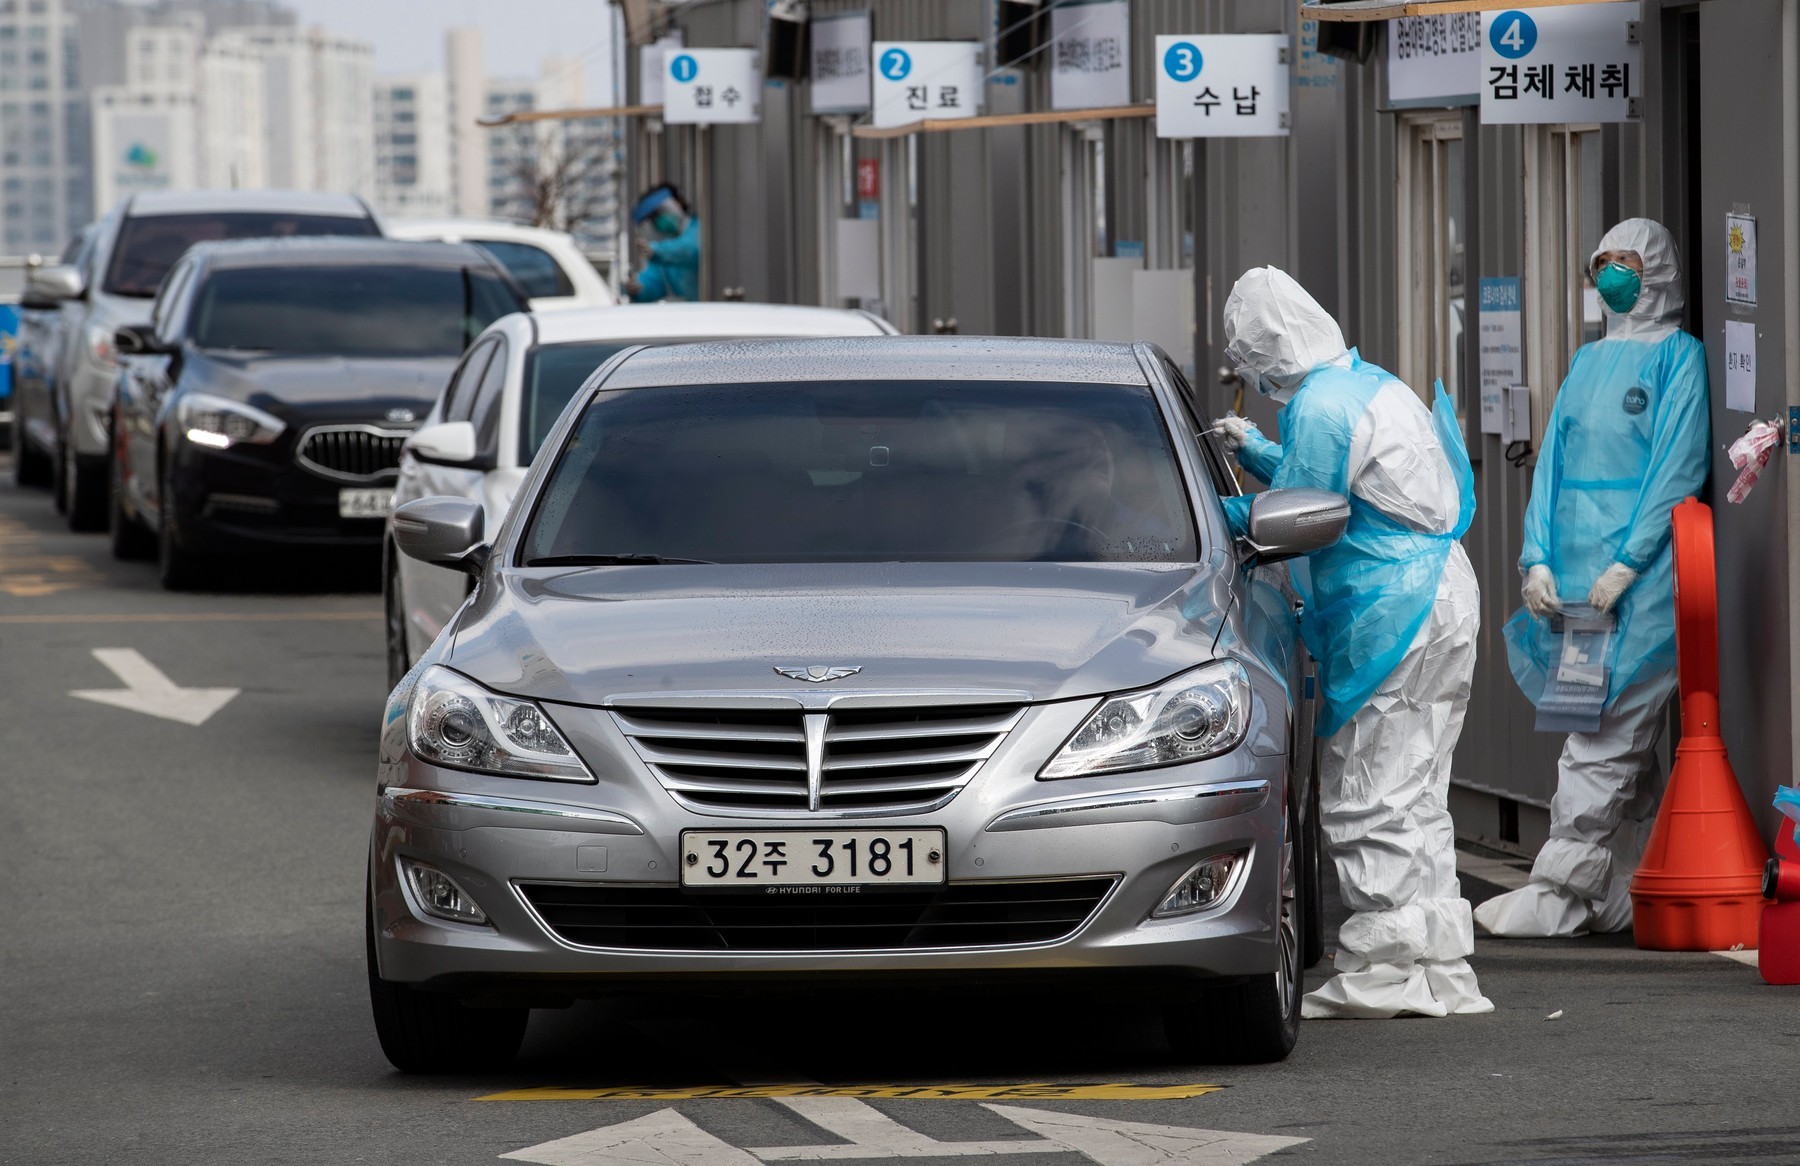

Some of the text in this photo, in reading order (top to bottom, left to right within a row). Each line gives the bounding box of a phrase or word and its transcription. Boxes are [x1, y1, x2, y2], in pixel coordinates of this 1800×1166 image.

[1500, 18, 1525, 50] 4
[887, 53, 902, 77] 2
[1175, 51, 1194, 76] 3
[1489, 63, 1629, 101] 검체 채취
[706, 838, 914, 878] 32주 3181
[779, 886, 861, 895] HYUNDAI FOR LIFE
